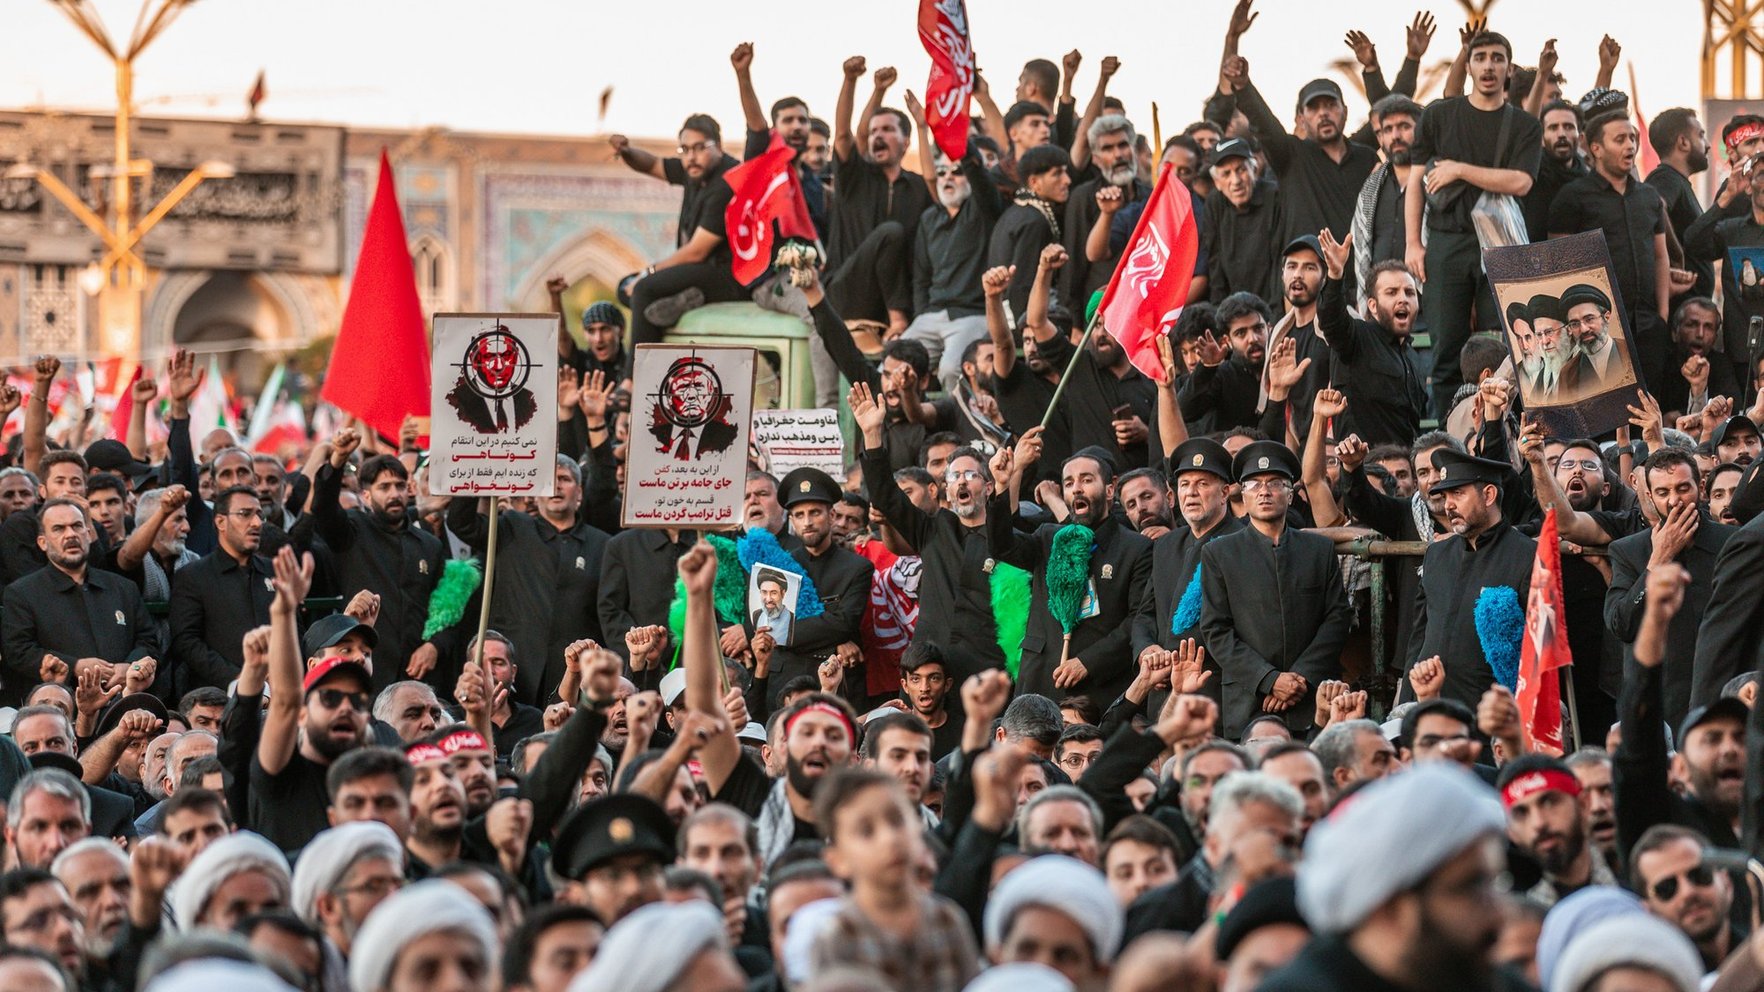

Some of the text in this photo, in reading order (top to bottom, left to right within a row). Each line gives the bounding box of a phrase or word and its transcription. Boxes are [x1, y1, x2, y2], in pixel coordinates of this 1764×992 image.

[760, 414, 795, 428] جغرافیا
[451, 436, 537, 448] نمی کنیم در این انتقام
[758, 433, 780, 444] ندارد
[452, 449, 536, 462] کوتاهی
[449, 466, 537, 479] که زنده ایم فقط از برای
[700, 465, 712, 475] این
[713, 465, 719, 475] از
[450, 480, 534, 493] خونخواهی
[639, 477, 732, 490] جای جامه بر تن ماست
[667, 497, 684, 506] خون
[695, 495, 714, 507] قسم
[635, 506, 732, 521] قتل ترامپ کردن ماست
